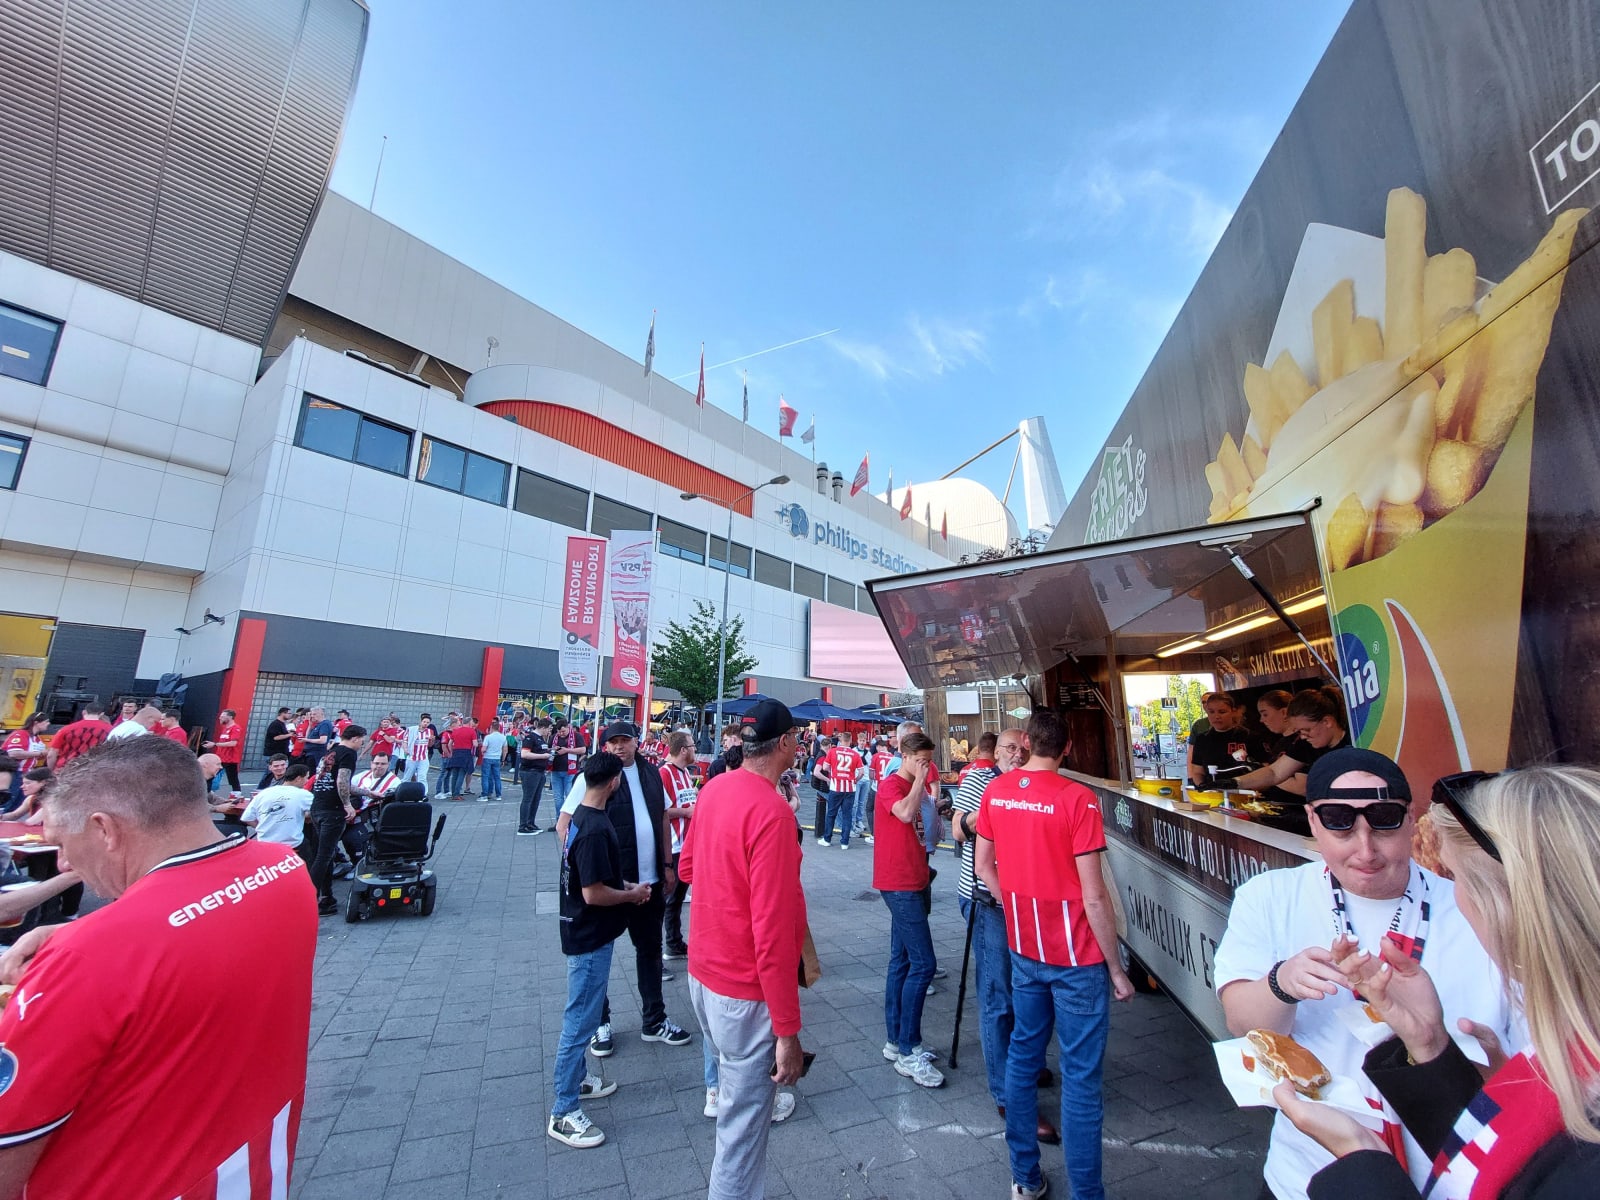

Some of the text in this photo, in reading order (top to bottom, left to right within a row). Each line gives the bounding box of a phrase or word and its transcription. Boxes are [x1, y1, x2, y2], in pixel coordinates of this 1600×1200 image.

[1544, 107, 1600, 181] TO
[1090, 434, 1133, 527] FRIET
[814, 521, 868, 560] philips
[1249, 648, 1304, 677] SMAKELIJK
[837, 754, 852, 771] 22
[990, 798, 1054, 815] energiedirect.nl
[1152, 817, 1197, 867] HEERLIJK
[1127, 885, 1197, 977] SMAKELIJK
